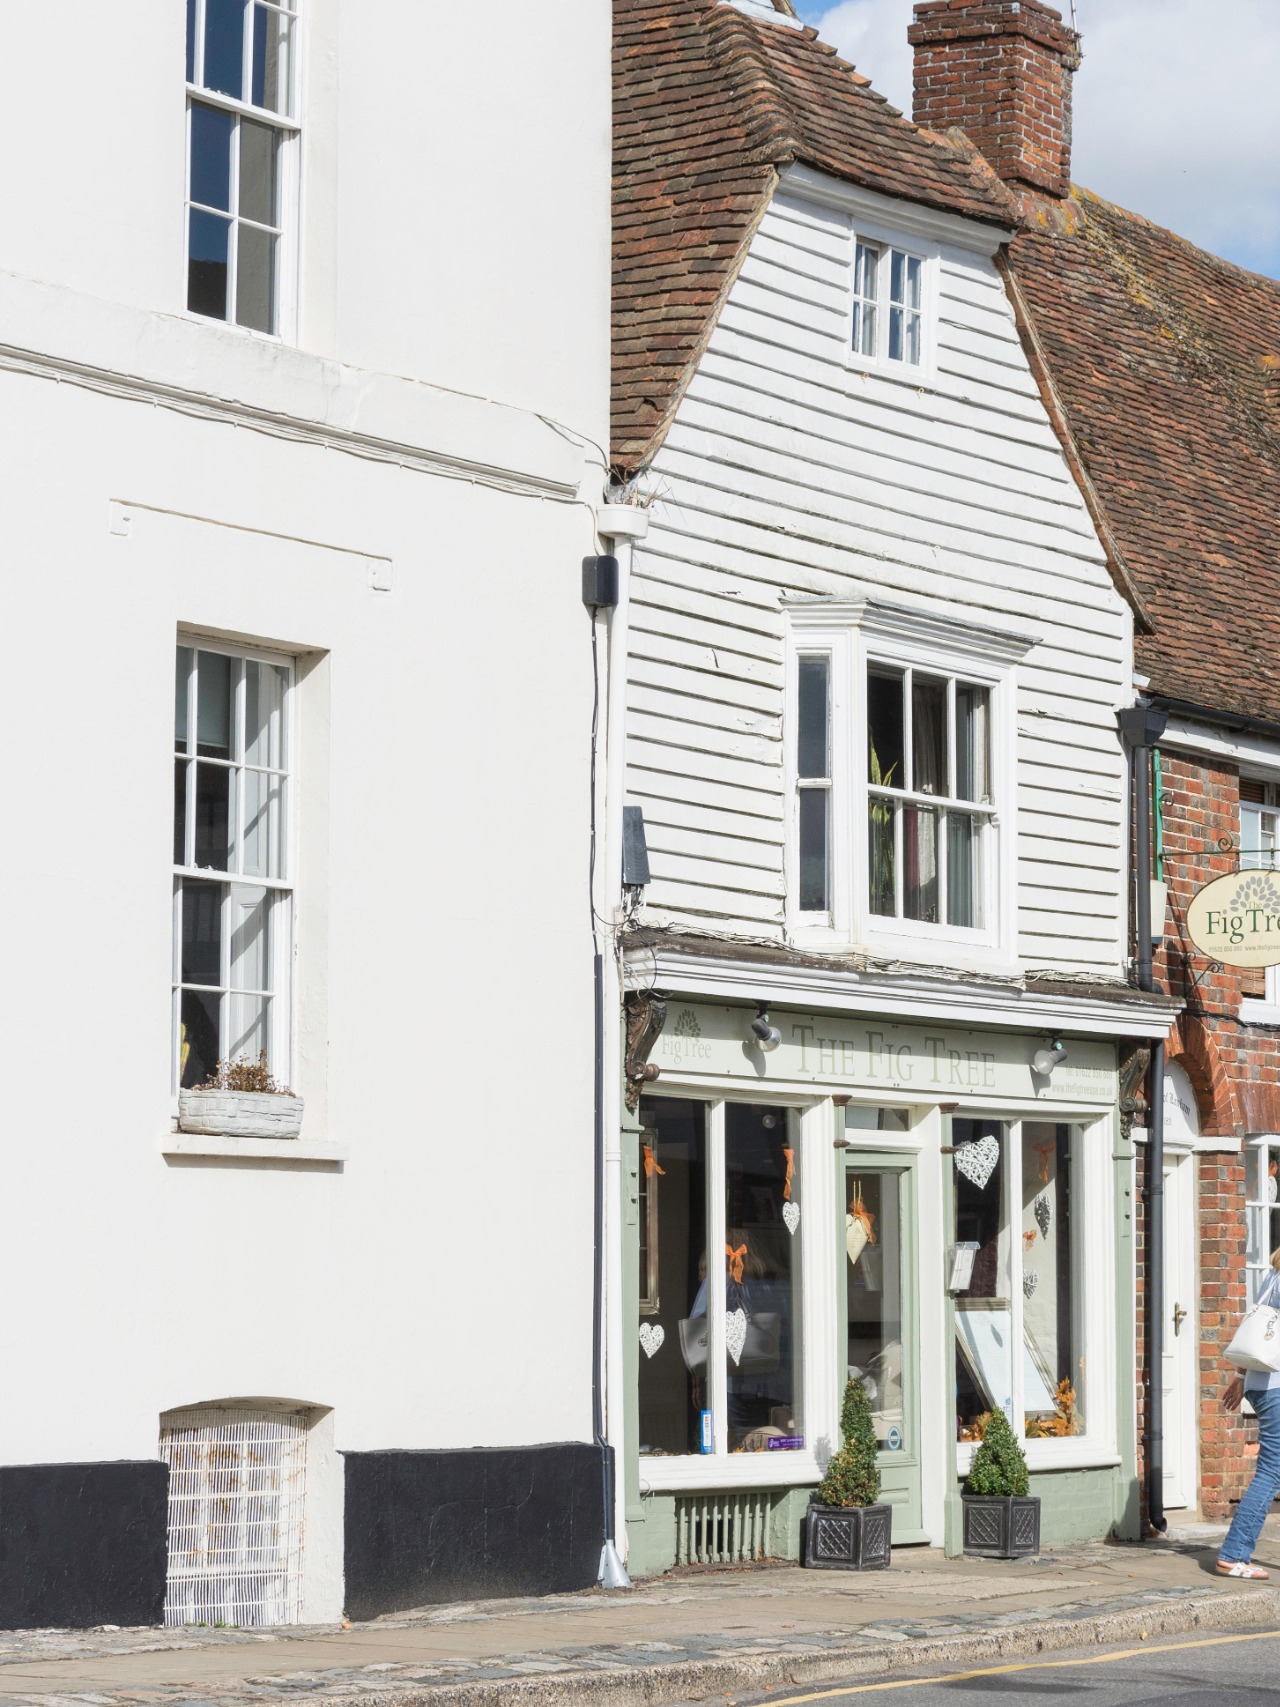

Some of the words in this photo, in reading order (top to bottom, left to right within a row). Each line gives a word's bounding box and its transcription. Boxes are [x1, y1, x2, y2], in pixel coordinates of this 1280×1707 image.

[791, 1023, 855, 1076] THE
[865, 1030, 915, 1081] FIG
[924, 1036, 996, 1088] TREE
